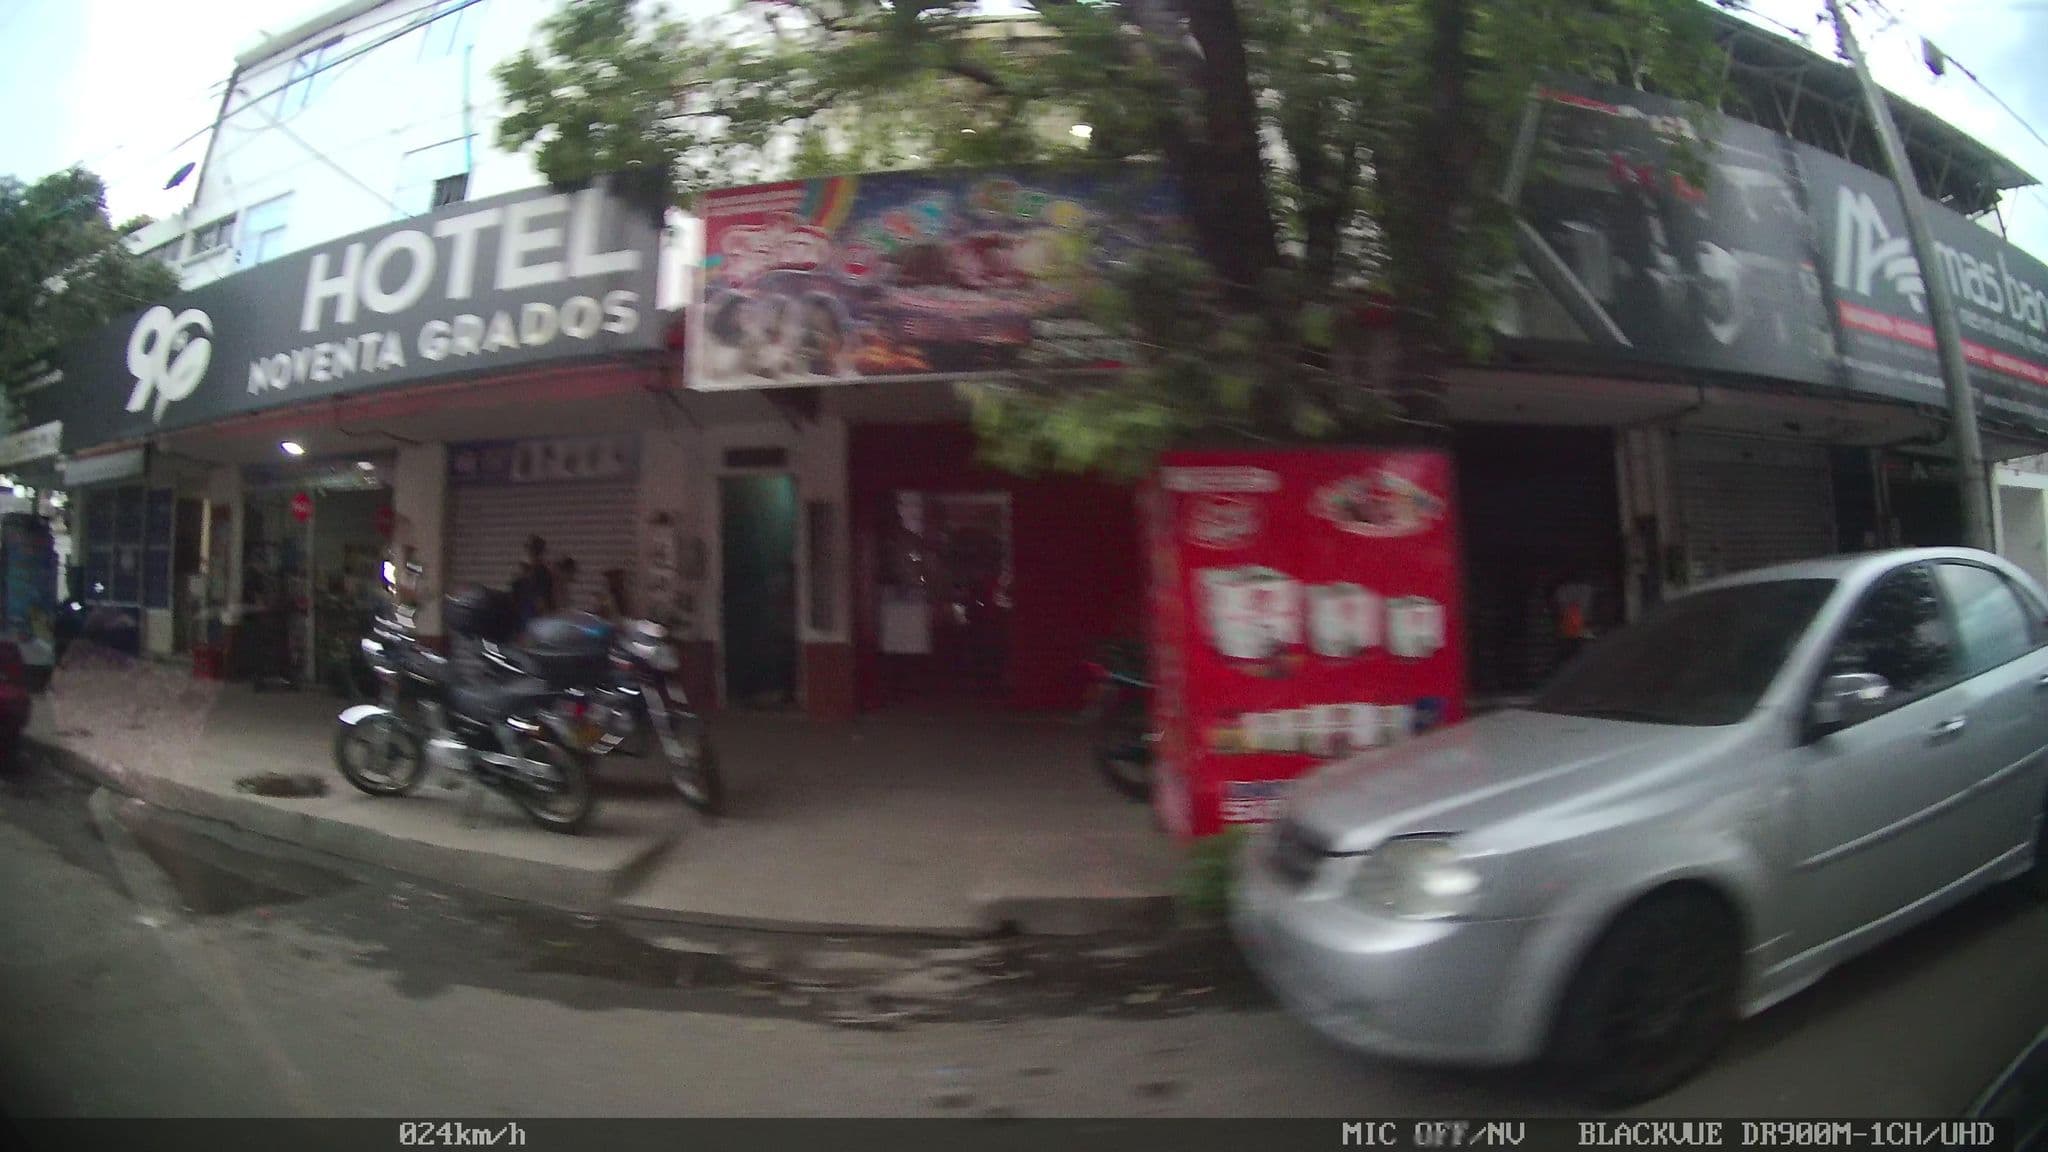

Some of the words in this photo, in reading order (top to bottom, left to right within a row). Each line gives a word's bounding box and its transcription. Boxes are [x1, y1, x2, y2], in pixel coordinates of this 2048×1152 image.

[301, 187, 641, 332] HOTEL
[247, 331, 407, 396] NOVENTA
[417, 289, 641, 361] GRADOS
